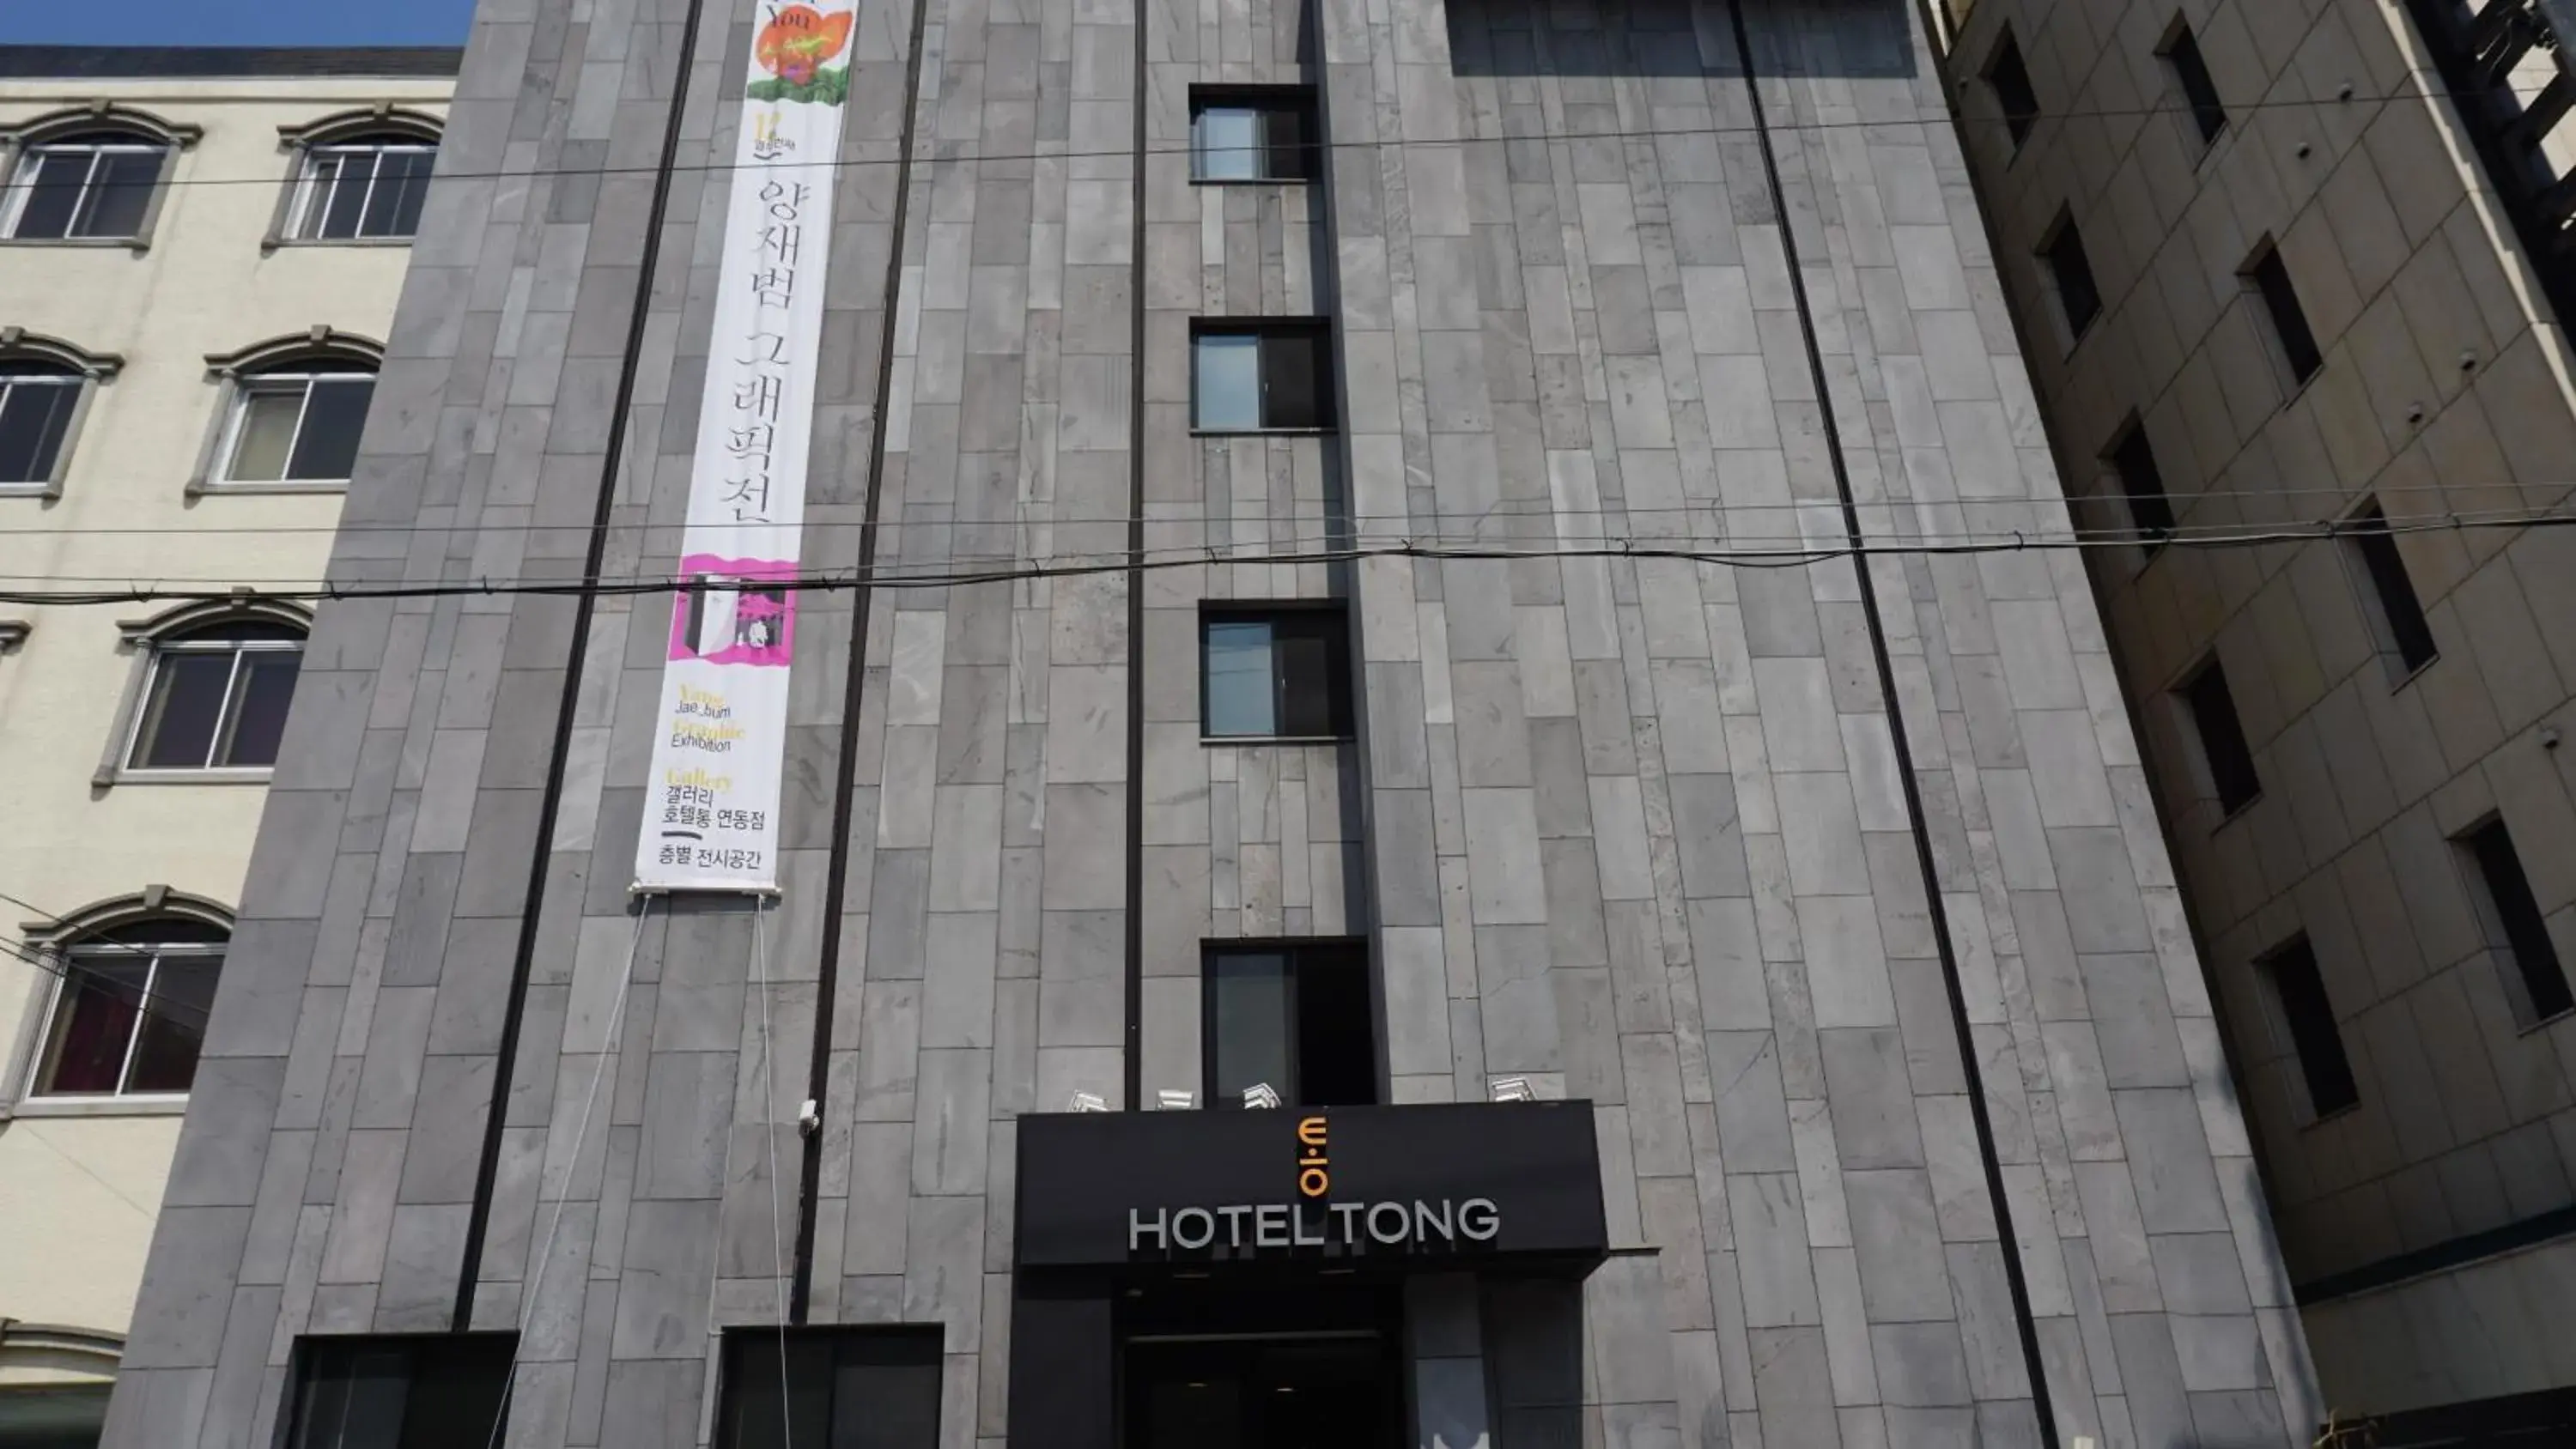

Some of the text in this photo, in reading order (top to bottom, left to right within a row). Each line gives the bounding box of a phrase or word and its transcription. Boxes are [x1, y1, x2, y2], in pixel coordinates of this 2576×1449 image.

[720, 179, 810, 523] 양재범 그래픽전
[671, 731, 731, 753] Exhibition
[666, 785, 714, 808] 갤러리
[717, 809, 765, 831] 연동점
[659, 844, 762, 870] 층별 전시공간
[1128, 1198, 1500, 1250] HOTEL TONG
